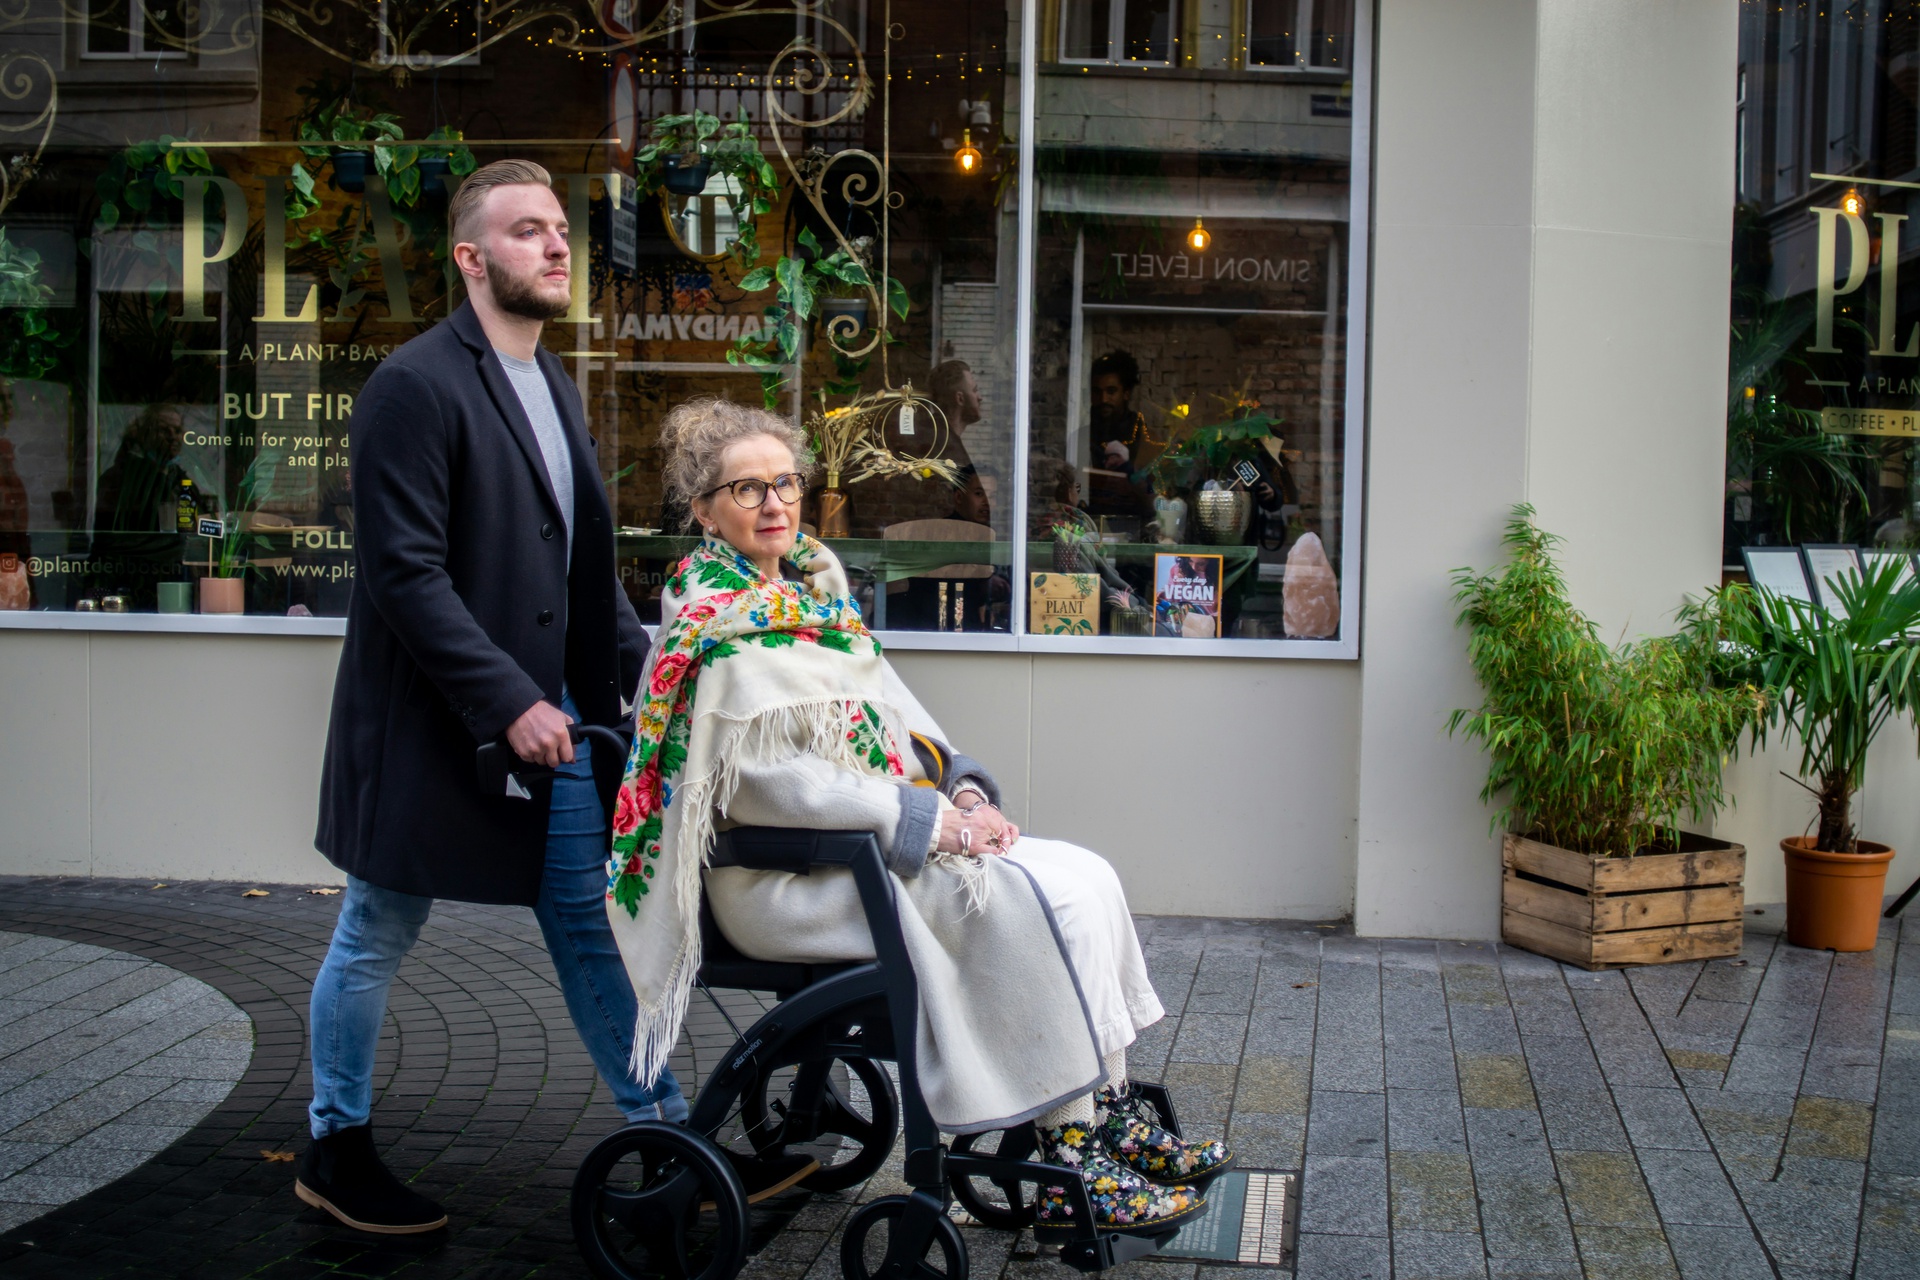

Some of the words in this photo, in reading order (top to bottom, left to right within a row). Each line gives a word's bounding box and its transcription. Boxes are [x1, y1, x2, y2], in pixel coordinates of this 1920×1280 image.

[171, 173, 621, 323] PLAT
[239, 343, 254, 361] A
[1858, 375, 1870, 393] A
[223, 392, 292, 420] BUT
[1827, 412, 1885, 430] COFFEE
[183, 431, 232, 446] Come
[239, 432, 254, 446] in
[261, 431, 286, 447] for
[293, 435, 332, 451] your
[288, 452, 317, 467] and
[292, 530, 354, 549] FOLL
[1164, 584, 1214, 601] VEGAN
[1046, 600, 1085, 614] PLANT
